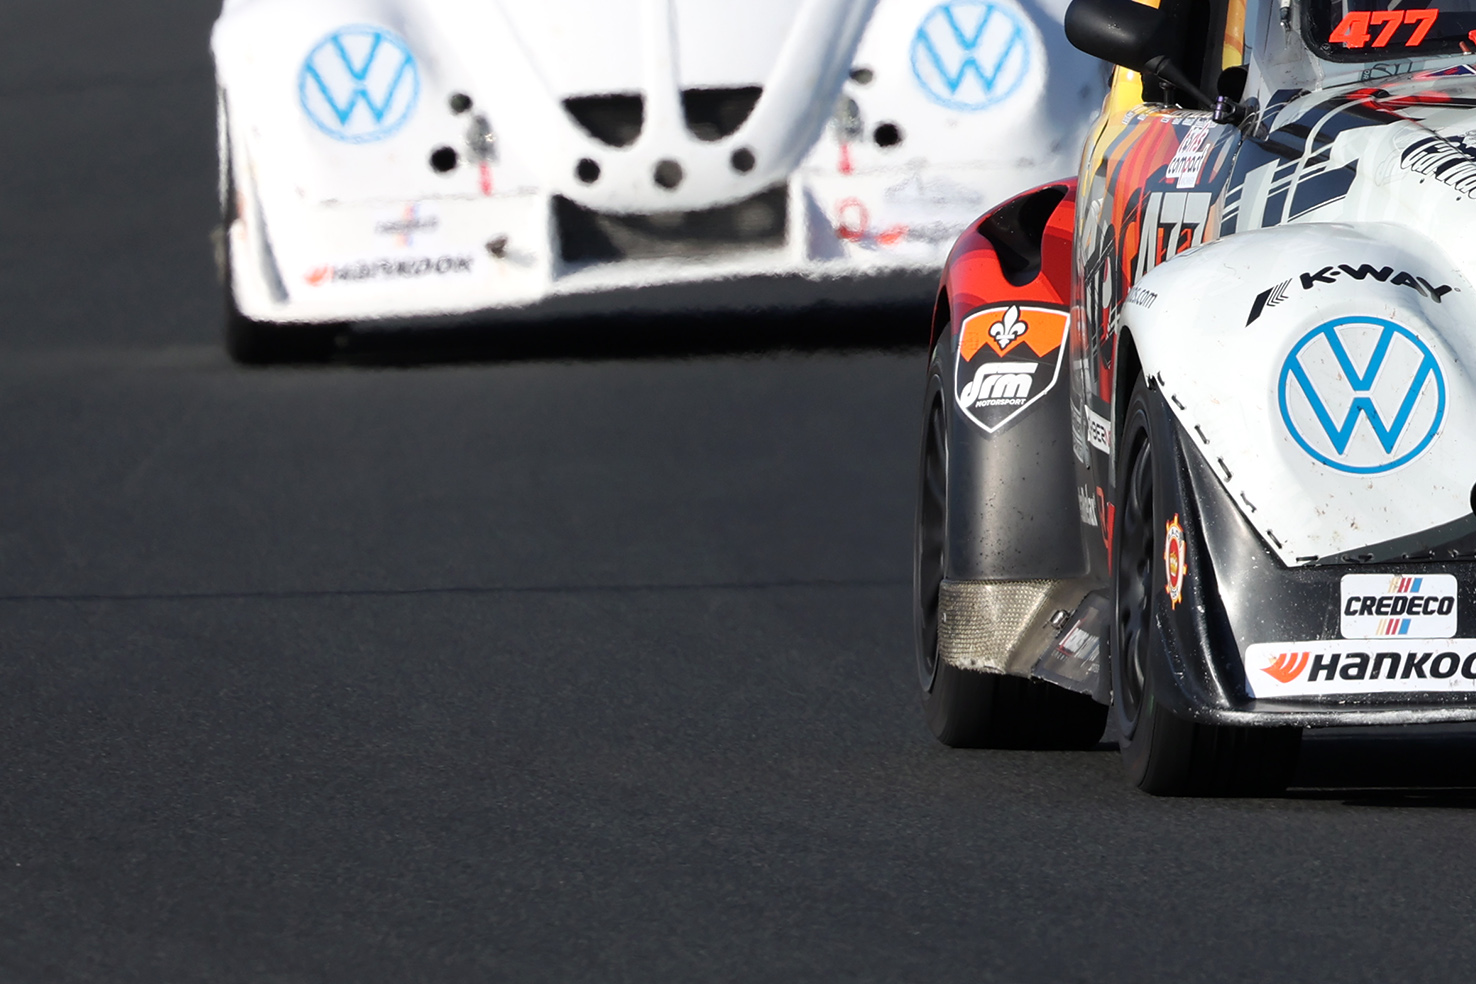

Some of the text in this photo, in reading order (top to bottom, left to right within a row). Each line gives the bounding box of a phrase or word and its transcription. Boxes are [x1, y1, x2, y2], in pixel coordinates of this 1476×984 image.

[1328, 8, 1440, 49] 477
[297, 22, 421, 144] VW
[975, 398, 1027, 408] MOTORSPORT
[1278, 316, 1446, 474] VW
[1344, 594, 1456, 616] CREDECO
